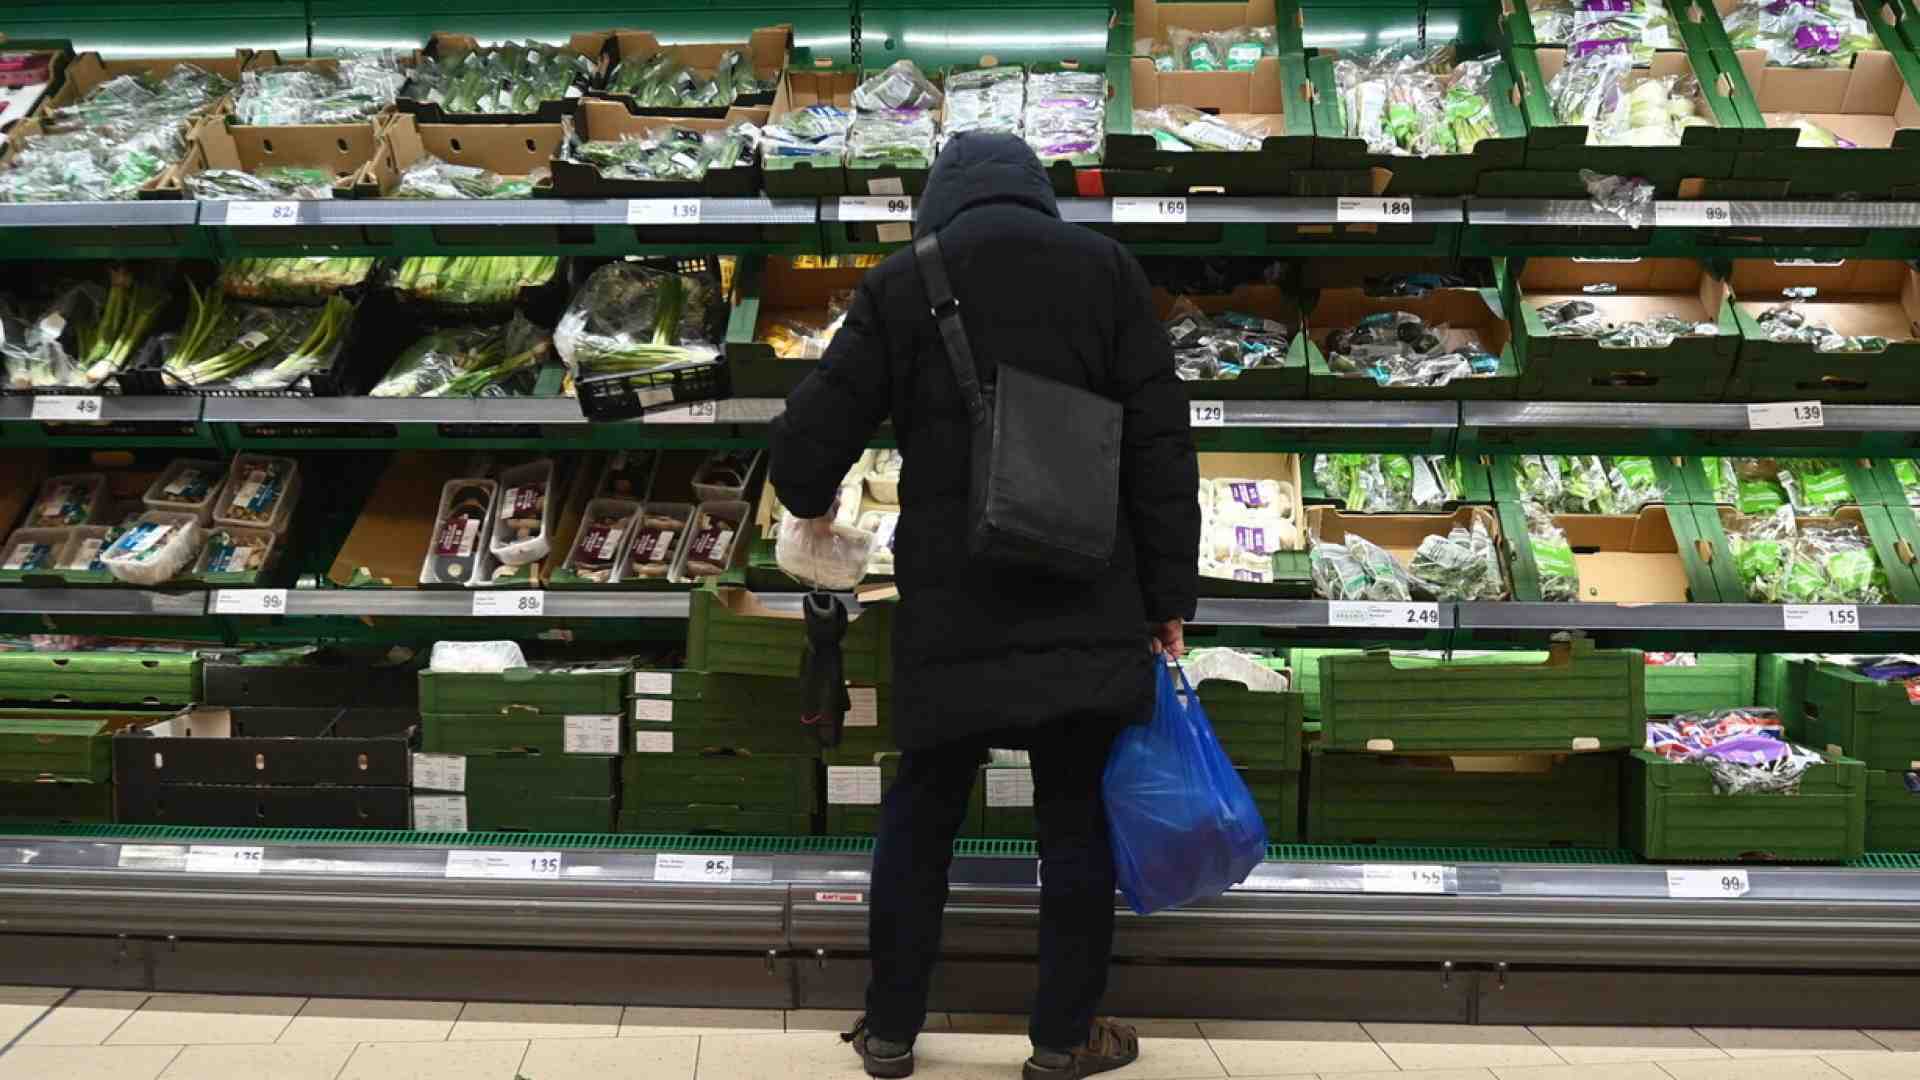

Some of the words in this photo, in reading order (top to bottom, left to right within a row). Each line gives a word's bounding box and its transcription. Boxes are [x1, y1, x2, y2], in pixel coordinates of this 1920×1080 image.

[1158, 200, 1185, 214] 1.69
[1382, 202, 1409, 216] 1.89
[1196, 407, 1221, 420] 1.29
[1794, 406, 1820, 420] 1.39
[1407, 609, 1438, 623] 2.49
[1829, 610, 1856, 624] 1.55
